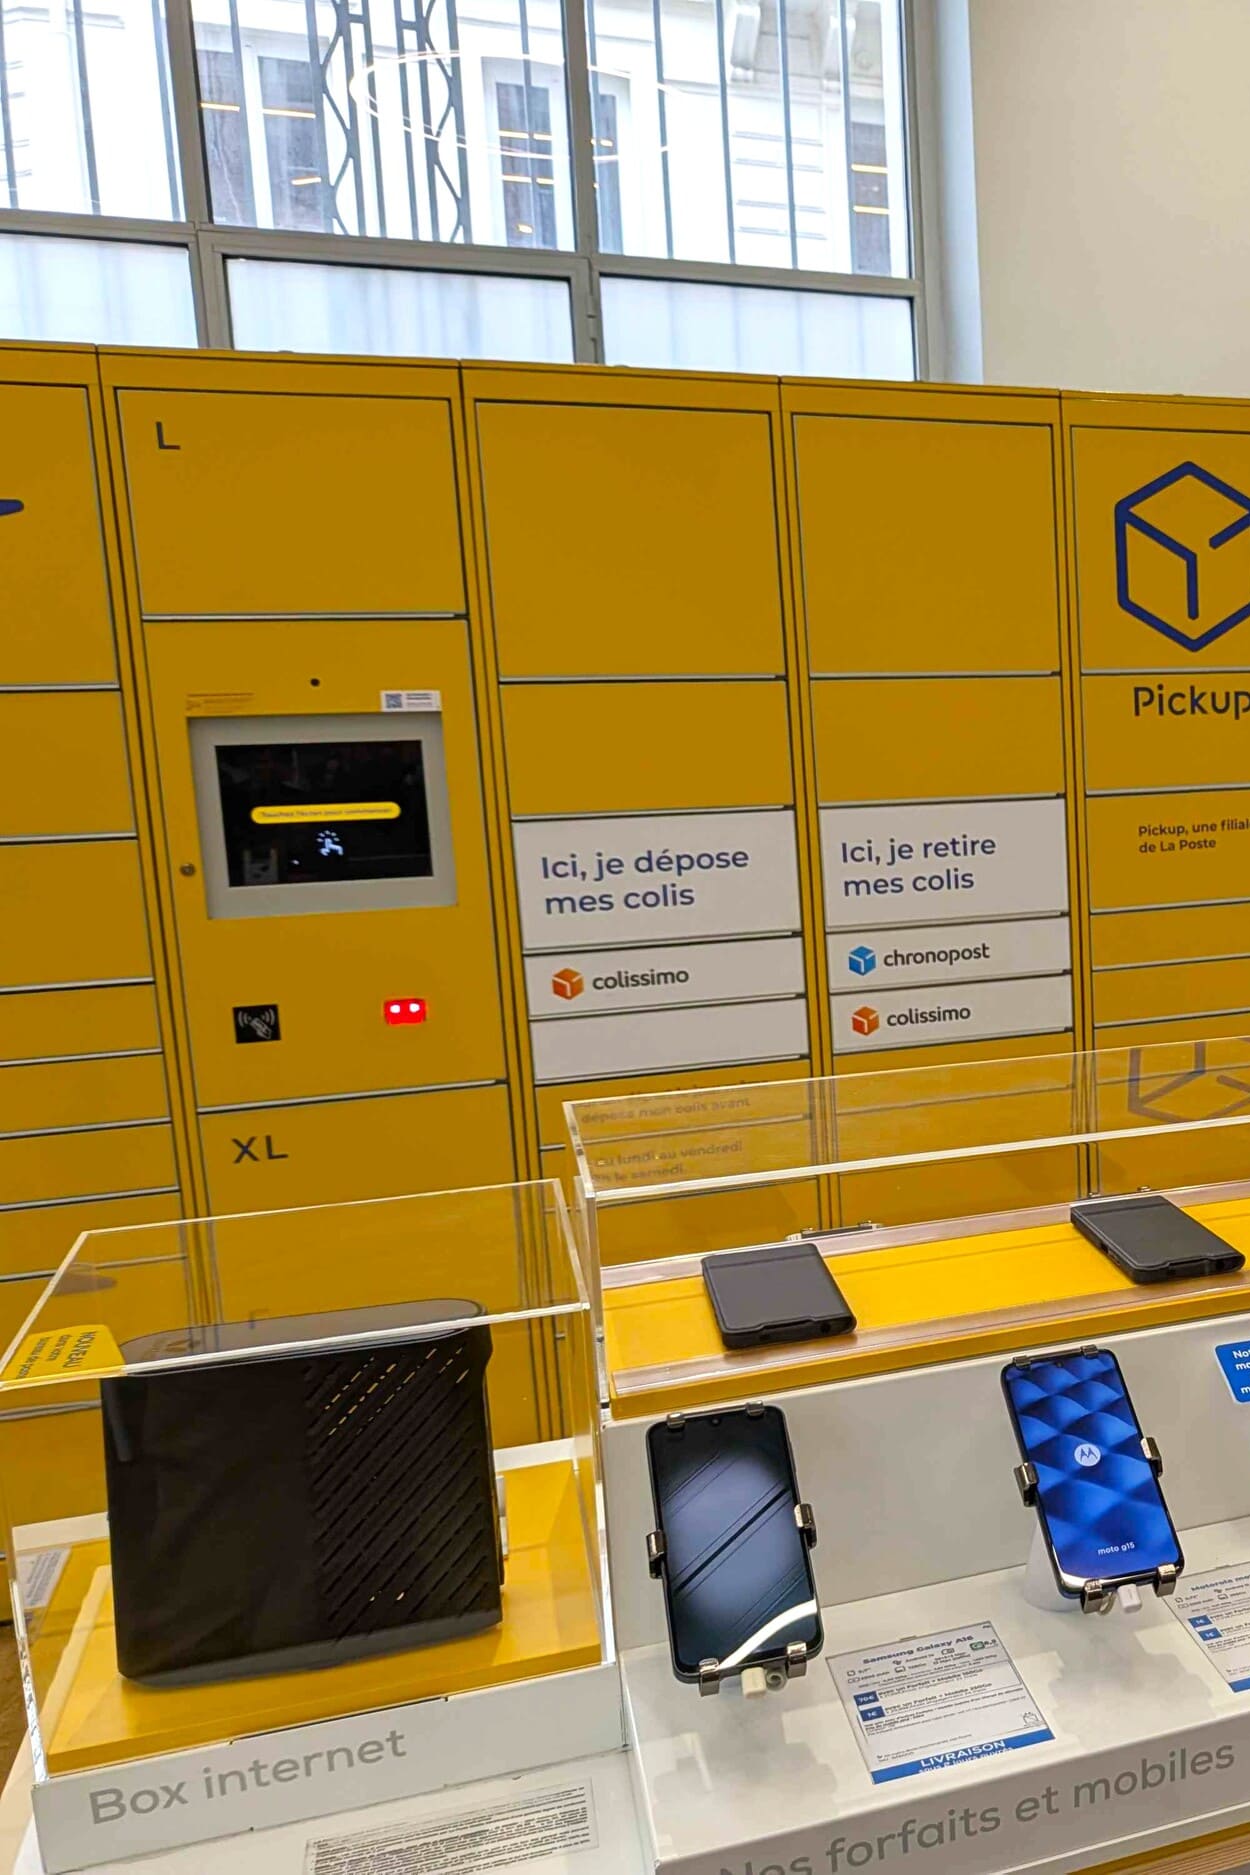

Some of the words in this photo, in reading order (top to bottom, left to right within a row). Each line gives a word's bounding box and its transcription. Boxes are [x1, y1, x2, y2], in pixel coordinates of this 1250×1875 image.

[156, 421, 181, 450] L
[1138, 824, 1189, 838] Pickup,
[1192, 821, 1217, 833] une
[841, 839, 881, 865] Ici,
[887, 837, 914, 866] je
[923, 834, 996, 859] retire
[1139, 842, 1156, 853] de
[1160, 840, 1175, 852] La
[1179, 838, 1216, 851] Poste
[541, 854, 587, 880] Ici,
[594, 852, 624, 882] je
[634, 849, 749, 876] dépose
[844, 876, 904, 897] mes
[912, 868, 974, 892] colis
[545, 893, 614, 915] mes
[624, 884, 695, 910] colis
[883, 943, 990, 967] chronopost
[592, 969, 689, 990] colissimo
[887, 1006, 971, 1026] colissimo
[231, 1134, 289, 1164] XL
[680, 1141, 743, 1156] vendredi
[1097, 1546, 1119, 1556] moto
[863, 1648, 914, 1665] Samsung
[917, 1640, 953, 1652] Galaxy
[920, 1740, 1006, 1768] LIVRAISON
[89, 1781, 189, 1824] Box
[202, 1730, 408, 1799] internet
[825, 1809, 1002, 1873] forfaits
[1014, 1785, 1060, 1823] et
[1073, 1743, 1236, 1808] mobiles
